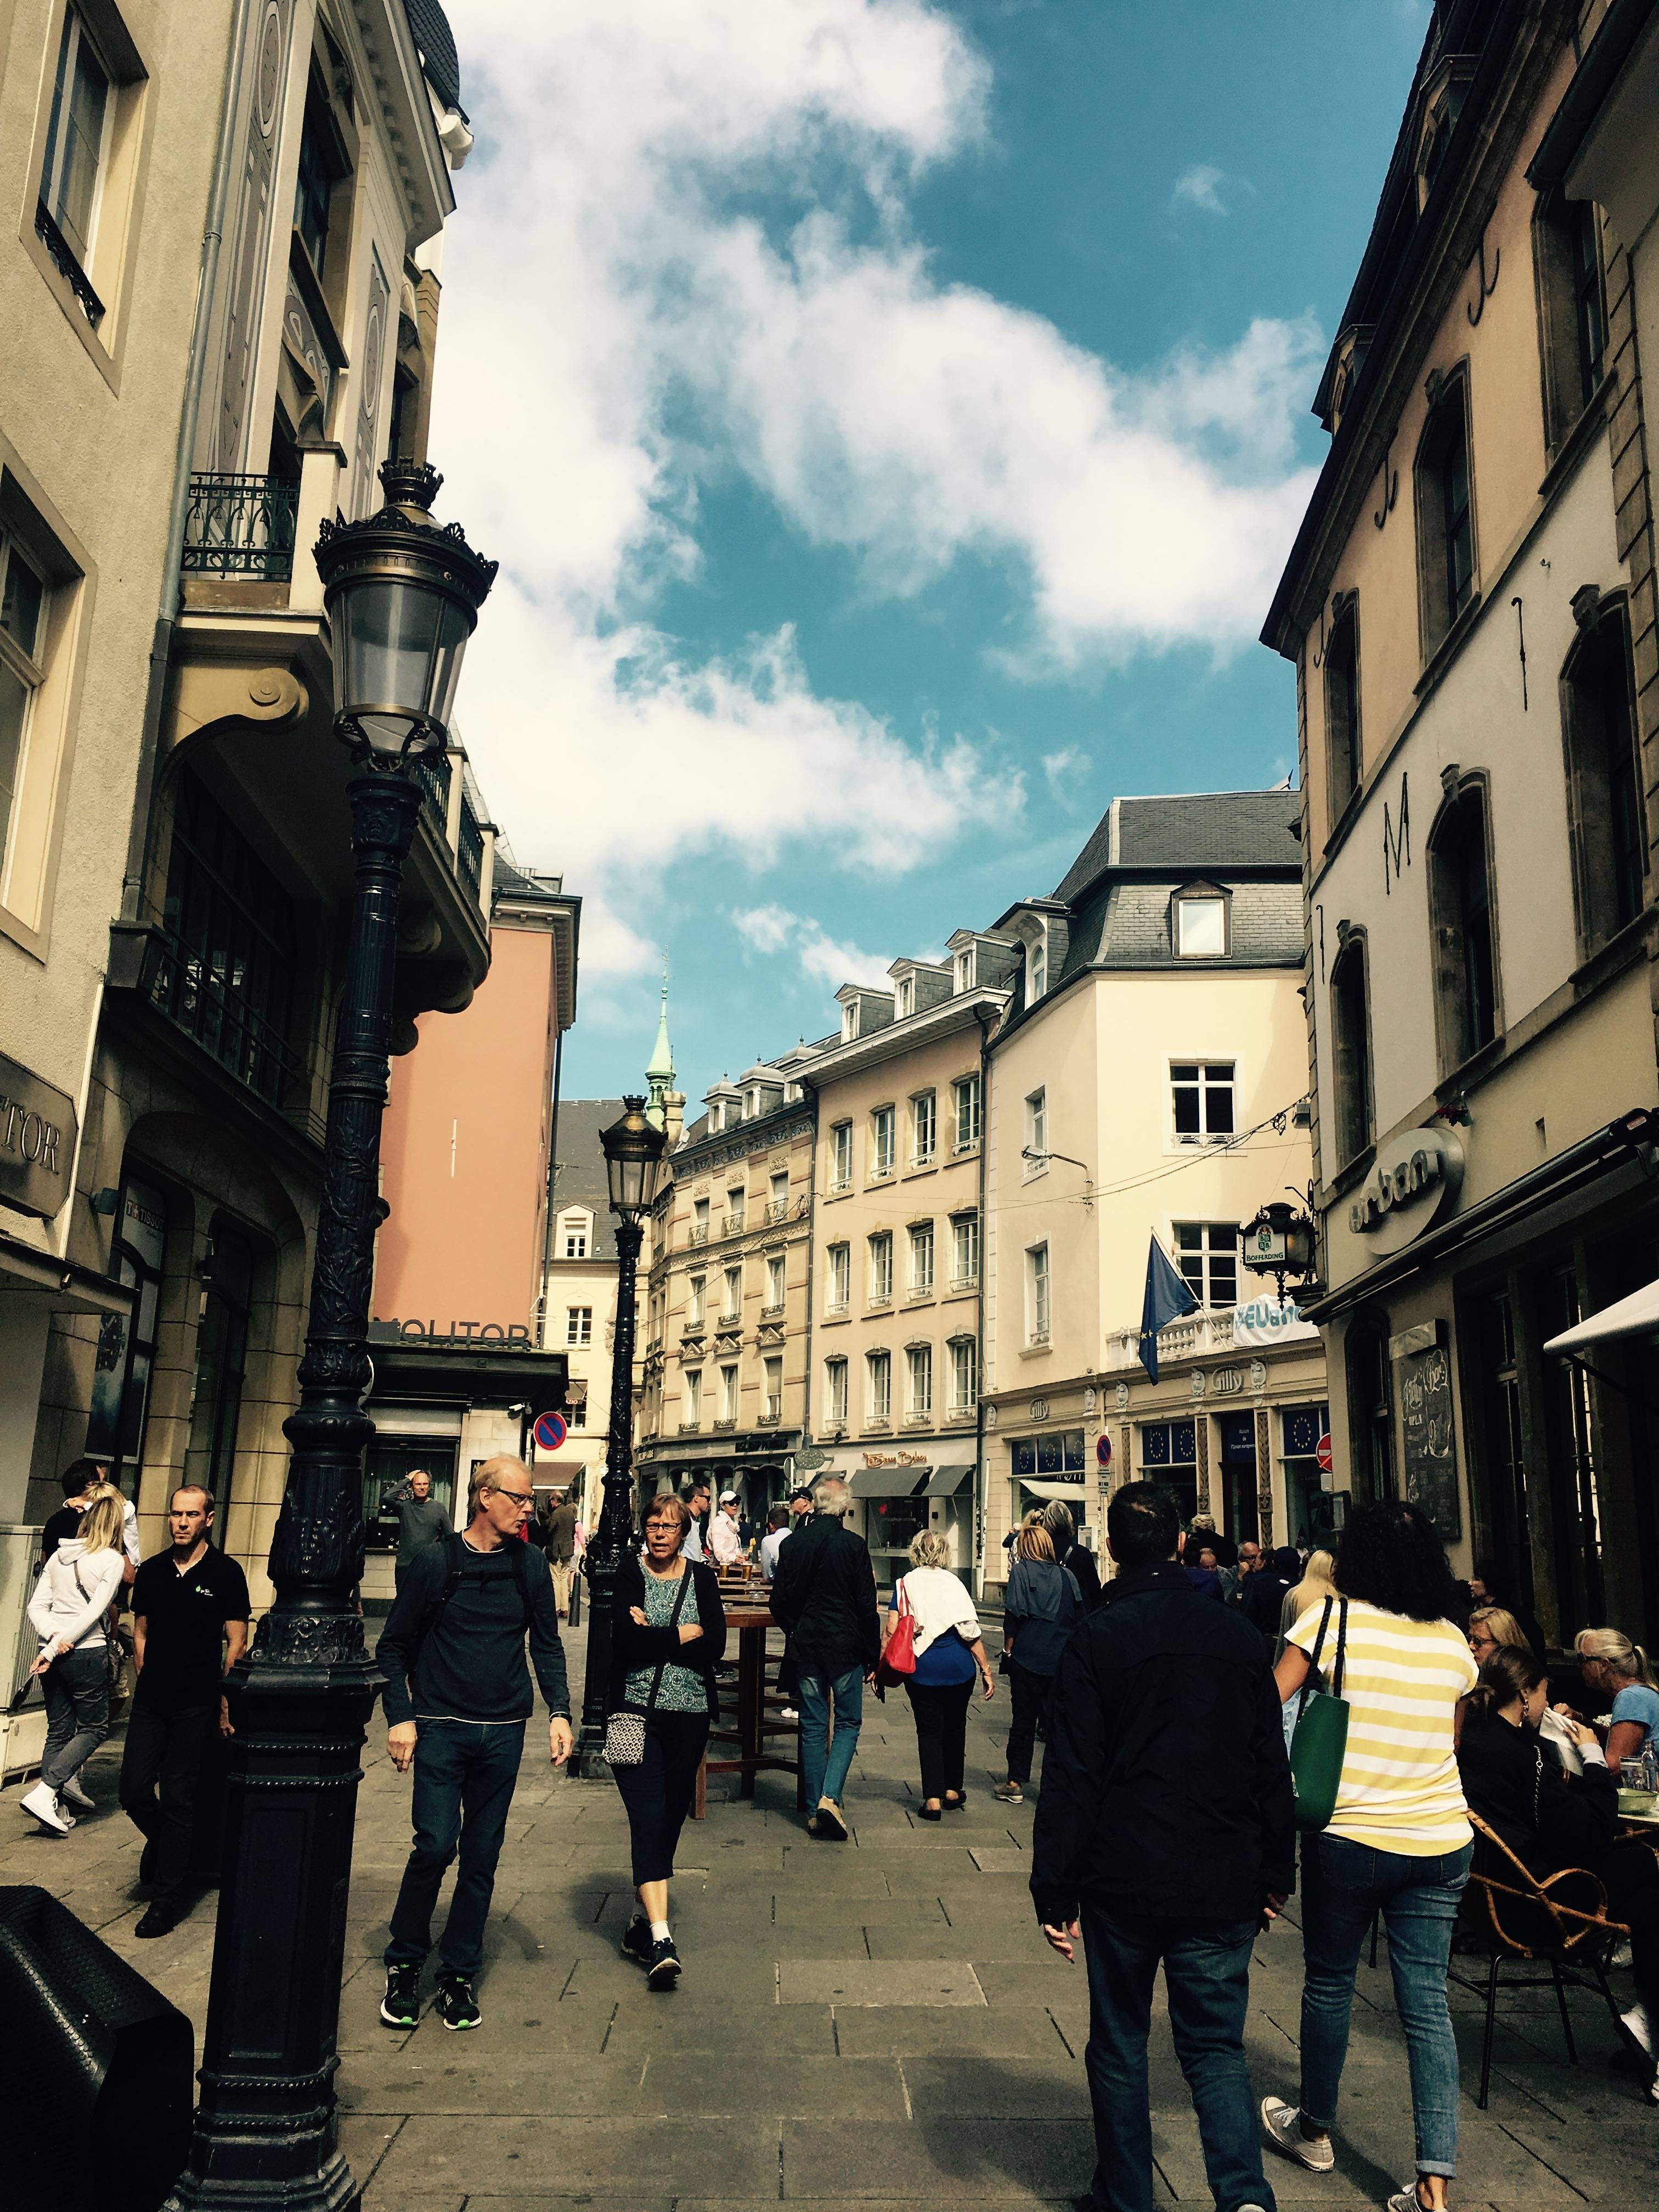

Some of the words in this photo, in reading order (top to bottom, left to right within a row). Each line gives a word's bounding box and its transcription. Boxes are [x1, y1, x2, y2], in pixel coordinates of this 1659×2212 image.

[1349, 1149, 1429, 1234] urban
[1246, 1252, 1284, 1261] BOFFERDING
[374, 1317, 531, 1350] OLITOR
